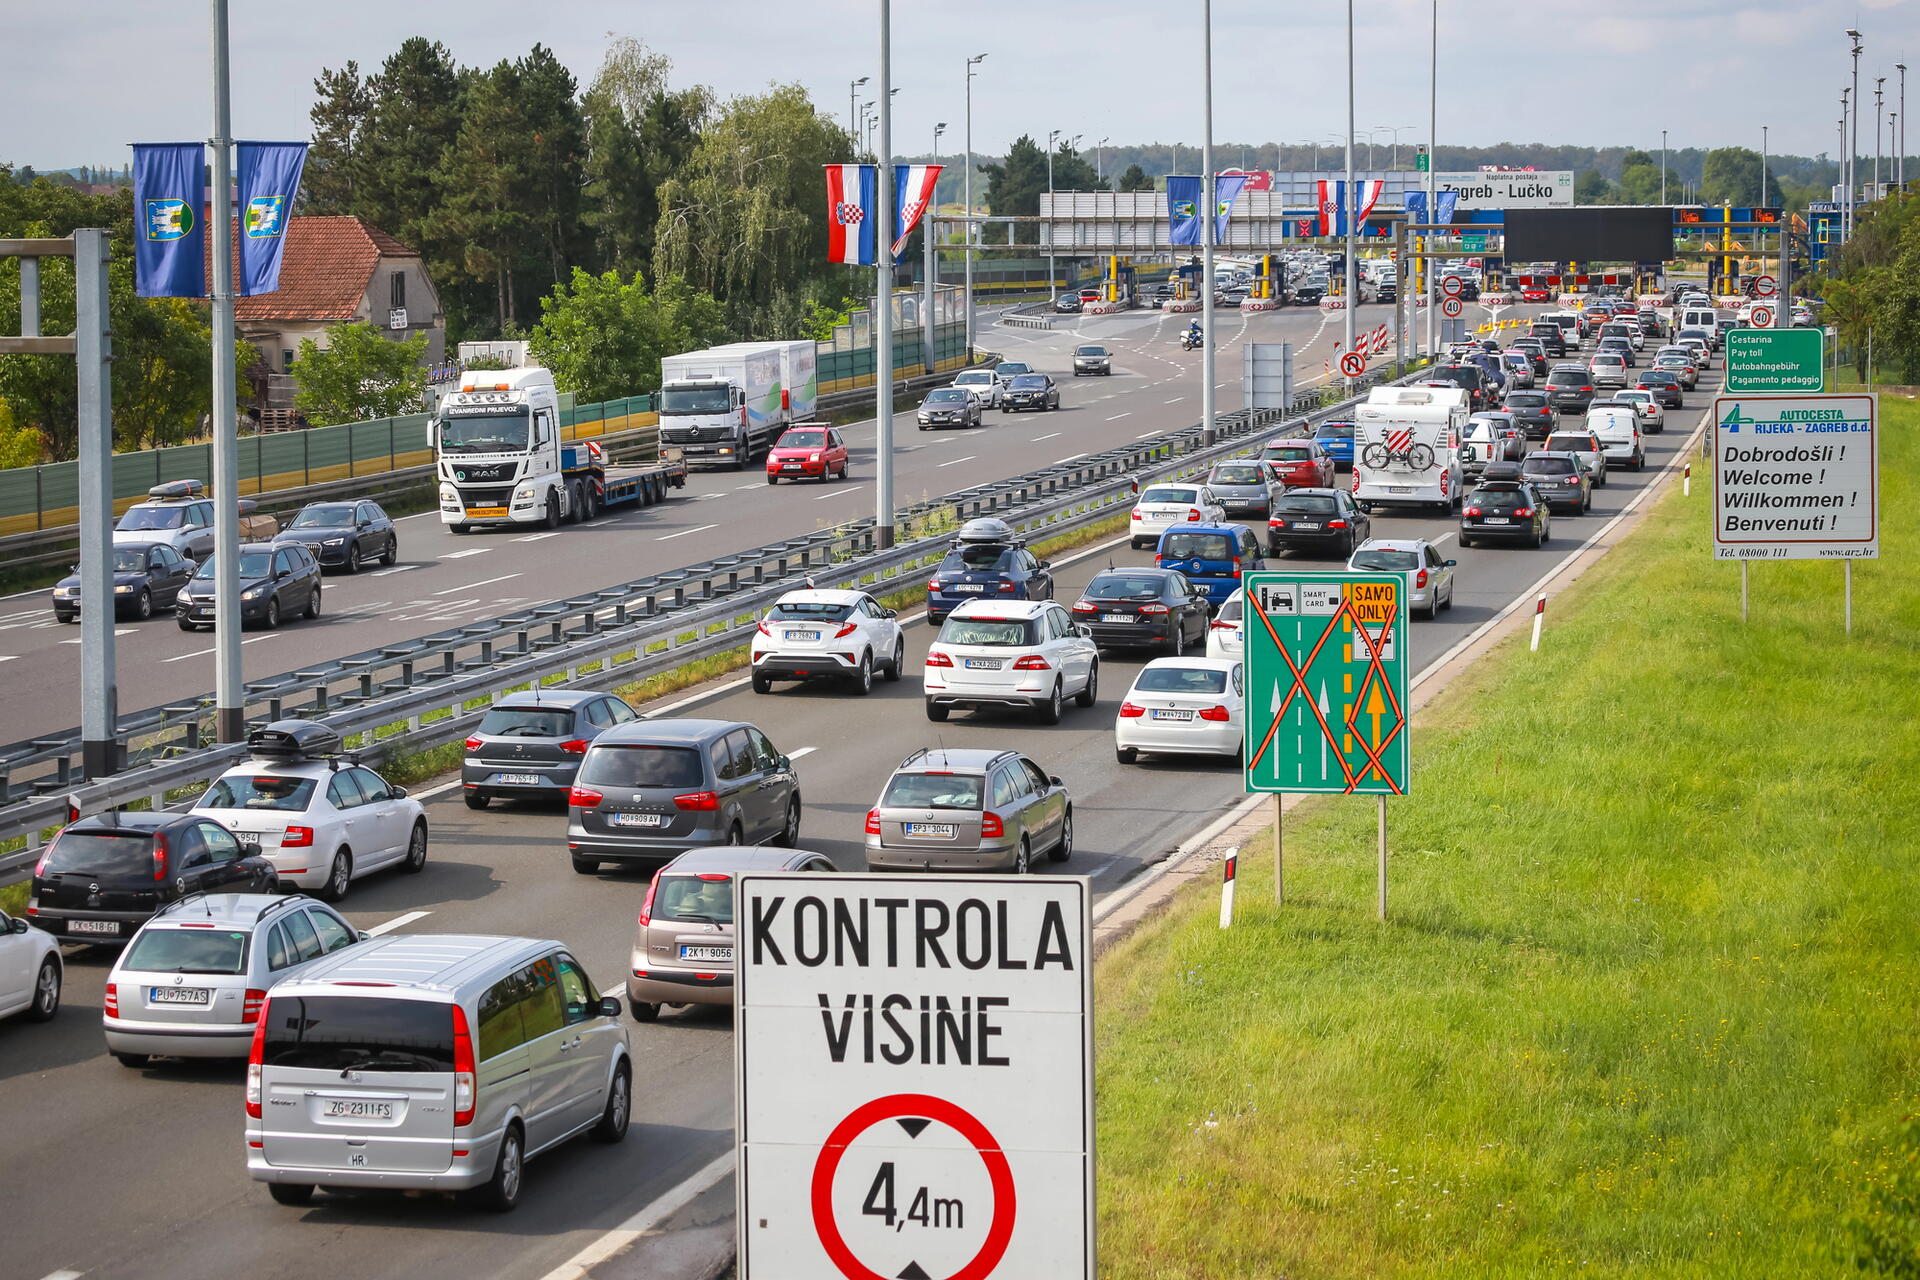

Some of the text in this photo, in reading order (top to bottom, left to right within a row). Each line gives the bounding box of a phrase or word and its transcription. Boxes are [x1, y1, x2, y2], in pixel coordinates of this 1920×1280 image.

[1486, 174, 1538, 182] Naplatna postaja
[1442, 184, 1492, 201] Zagreb
[1509, 184, 1552, 198] Lučko
[1447, 302, 1458, 312] 40
[1755, 312, 1767, 322] 40
[1731, 336, 1772, 344] Cestarina
[1732, 349, 1763, 358] Pay toll
[1731, 362, 1800, 372] Autobahngebühr
[1732, 376, 1819, 385] Pagamento pedaggio
[1780, 410, 1844, 420] AUTOCESTA
[1755, 424, 1794, 434] RIJEKA
[1805, 423, 1848, 433] ZAGREB
[1851, 422, 1871, 432] d.d.
[1724, 446, 1846, 462] Dobrodošli !
[471, 470, 499, 478] MAN
[1724, 469, 1826, 485] Welcome !
[1724, 492, 1857, 508] Willkommen !
[1725, 515, 1837, 531] Benvenuti !
[1720, 548, 1788, 557] Tel. 08000 111
[1819, 548, 1874, 557] www.arz.hr
[1355, 586, 1392, 601] SAMO
[1358, 605, 1390, 619] ONLY
[932, 825, 949, 833] 3044
[752, 896, 1074, 970] KONTROLA
[688, 948, 731, 958] 2K1 9056
[818, 993, 1010, 1066] VISINE
[332, 1102, 344, 1113] ZG
[352, 1155, 364, 1166] HR
[862, 1162, 963, 1232] 4,4m
